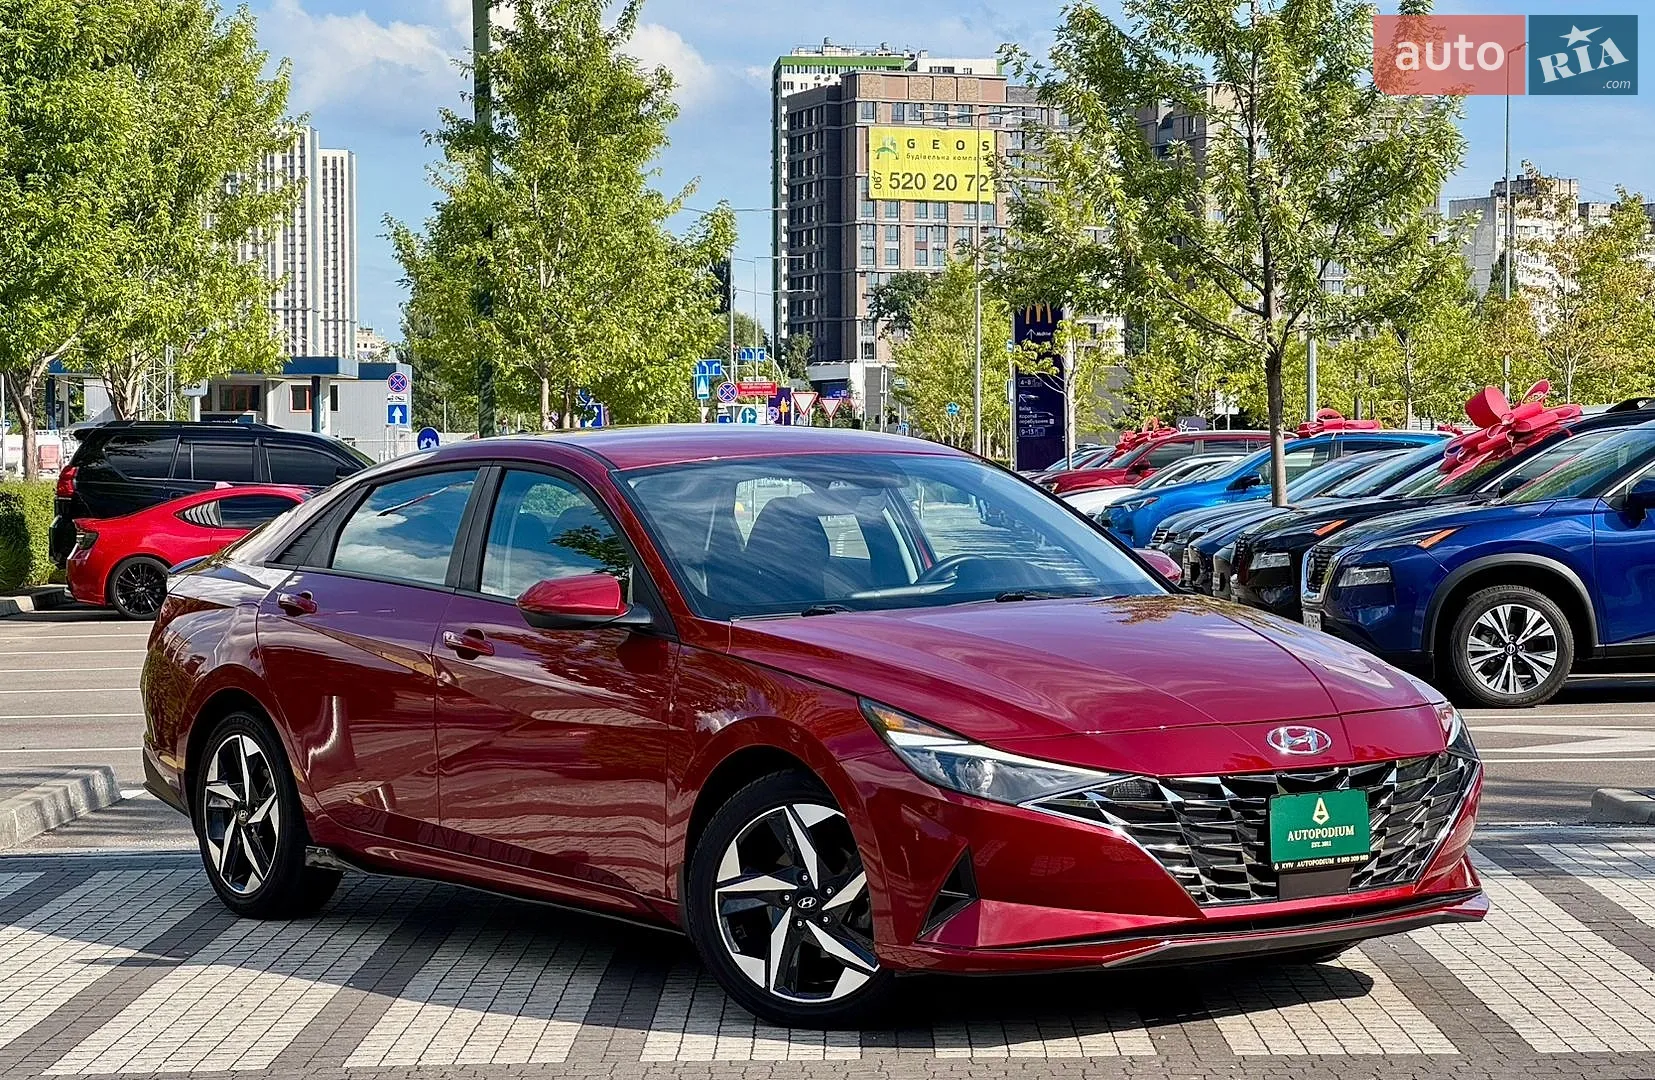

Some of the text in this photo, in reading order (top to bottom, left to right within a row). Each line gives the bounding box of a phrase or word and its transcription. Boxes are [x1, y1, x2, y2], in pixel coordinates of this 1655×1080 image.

[906, 138, 990, 152] GEOS
[906, 152, 950, 161] будівельна
[873, 170, 989, 192] 067 520 20 72
[1288, 825, 1354, 841] AUTOPODIUM
[1296, 858, 1334, 868] AUTOPODIUM
